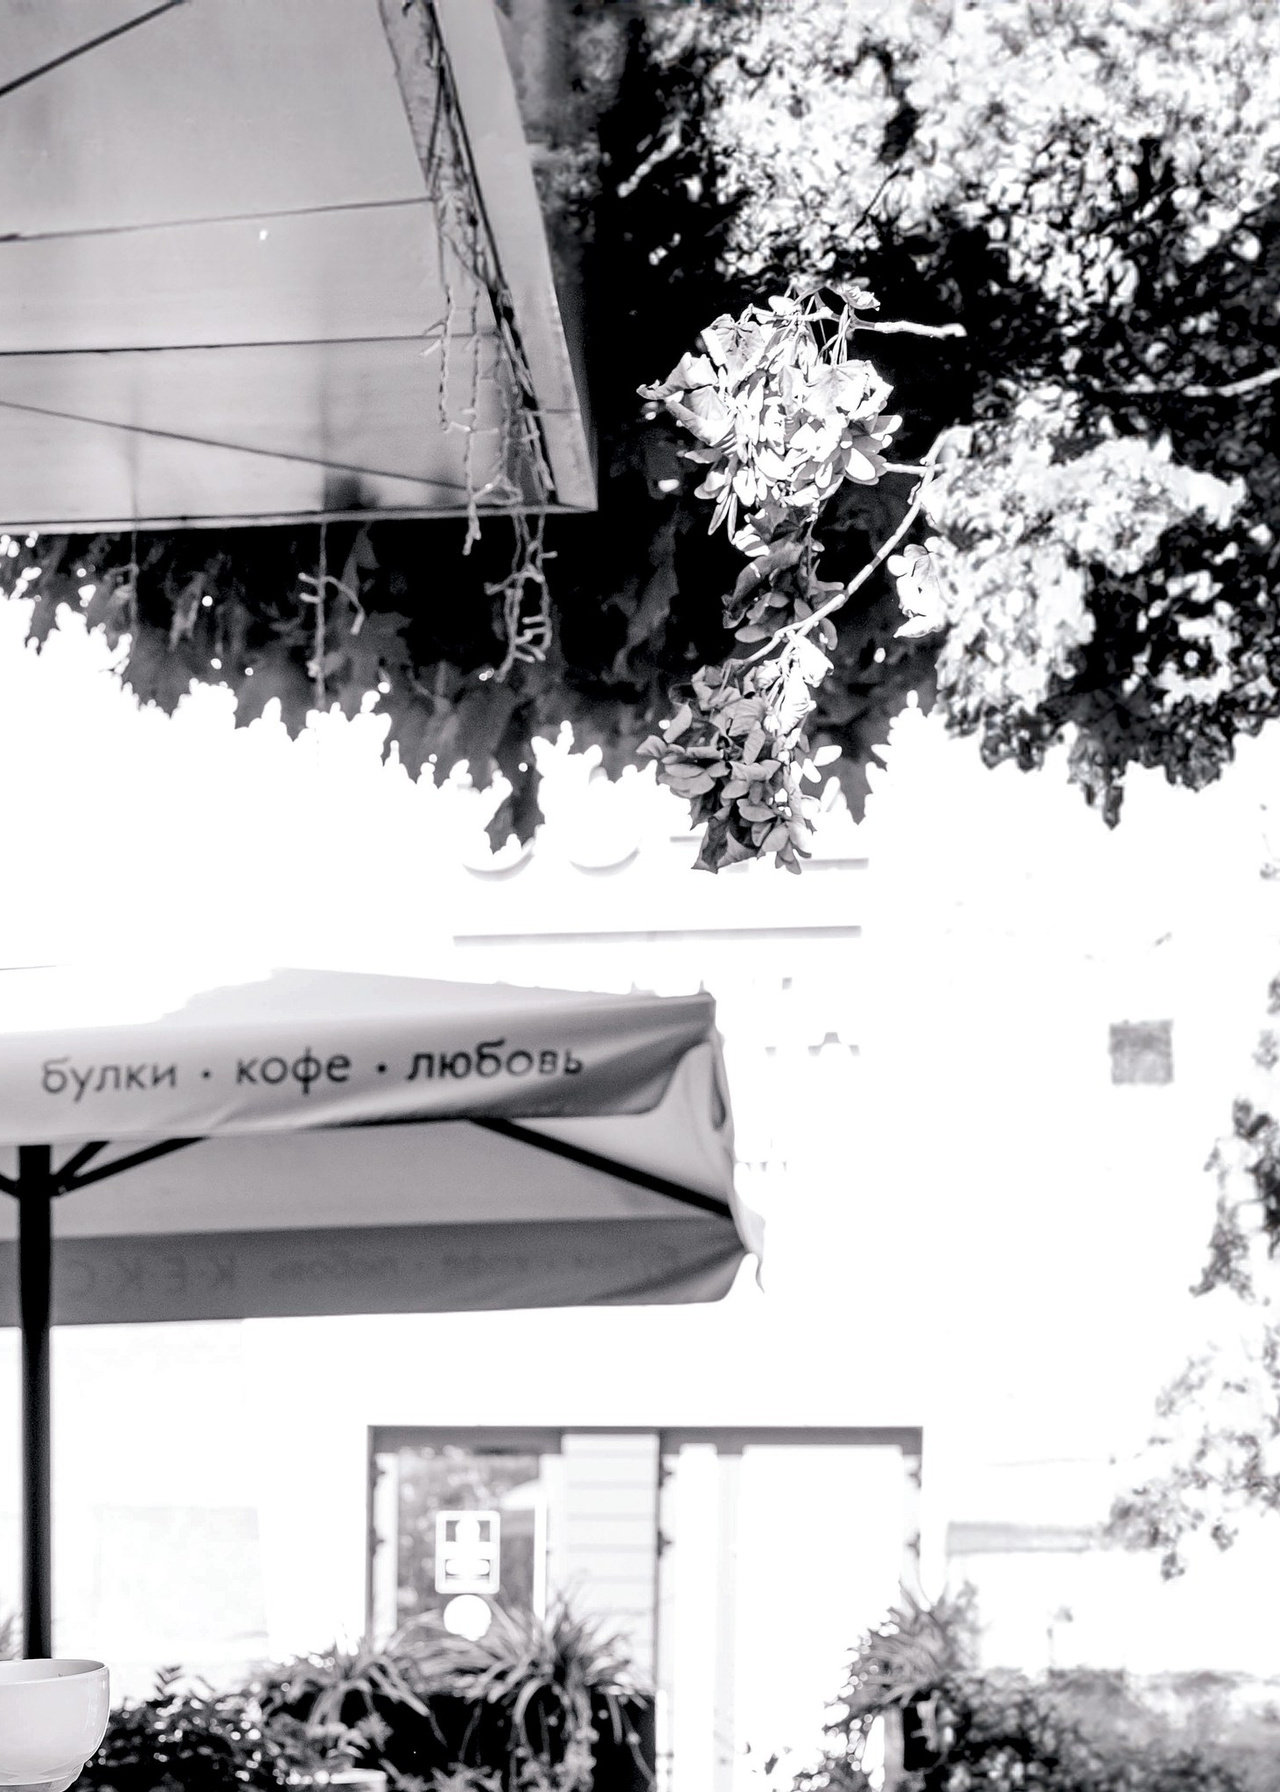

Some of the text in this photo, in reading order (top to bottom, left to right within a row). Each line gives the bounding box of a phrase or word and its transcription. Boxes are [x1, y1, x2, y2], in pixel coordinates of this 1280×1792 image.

[41, 1057, 177, 1101] булки
[235, 1046, 351, 1095] кофе
[406, 1037, 583, 1082] любовь
